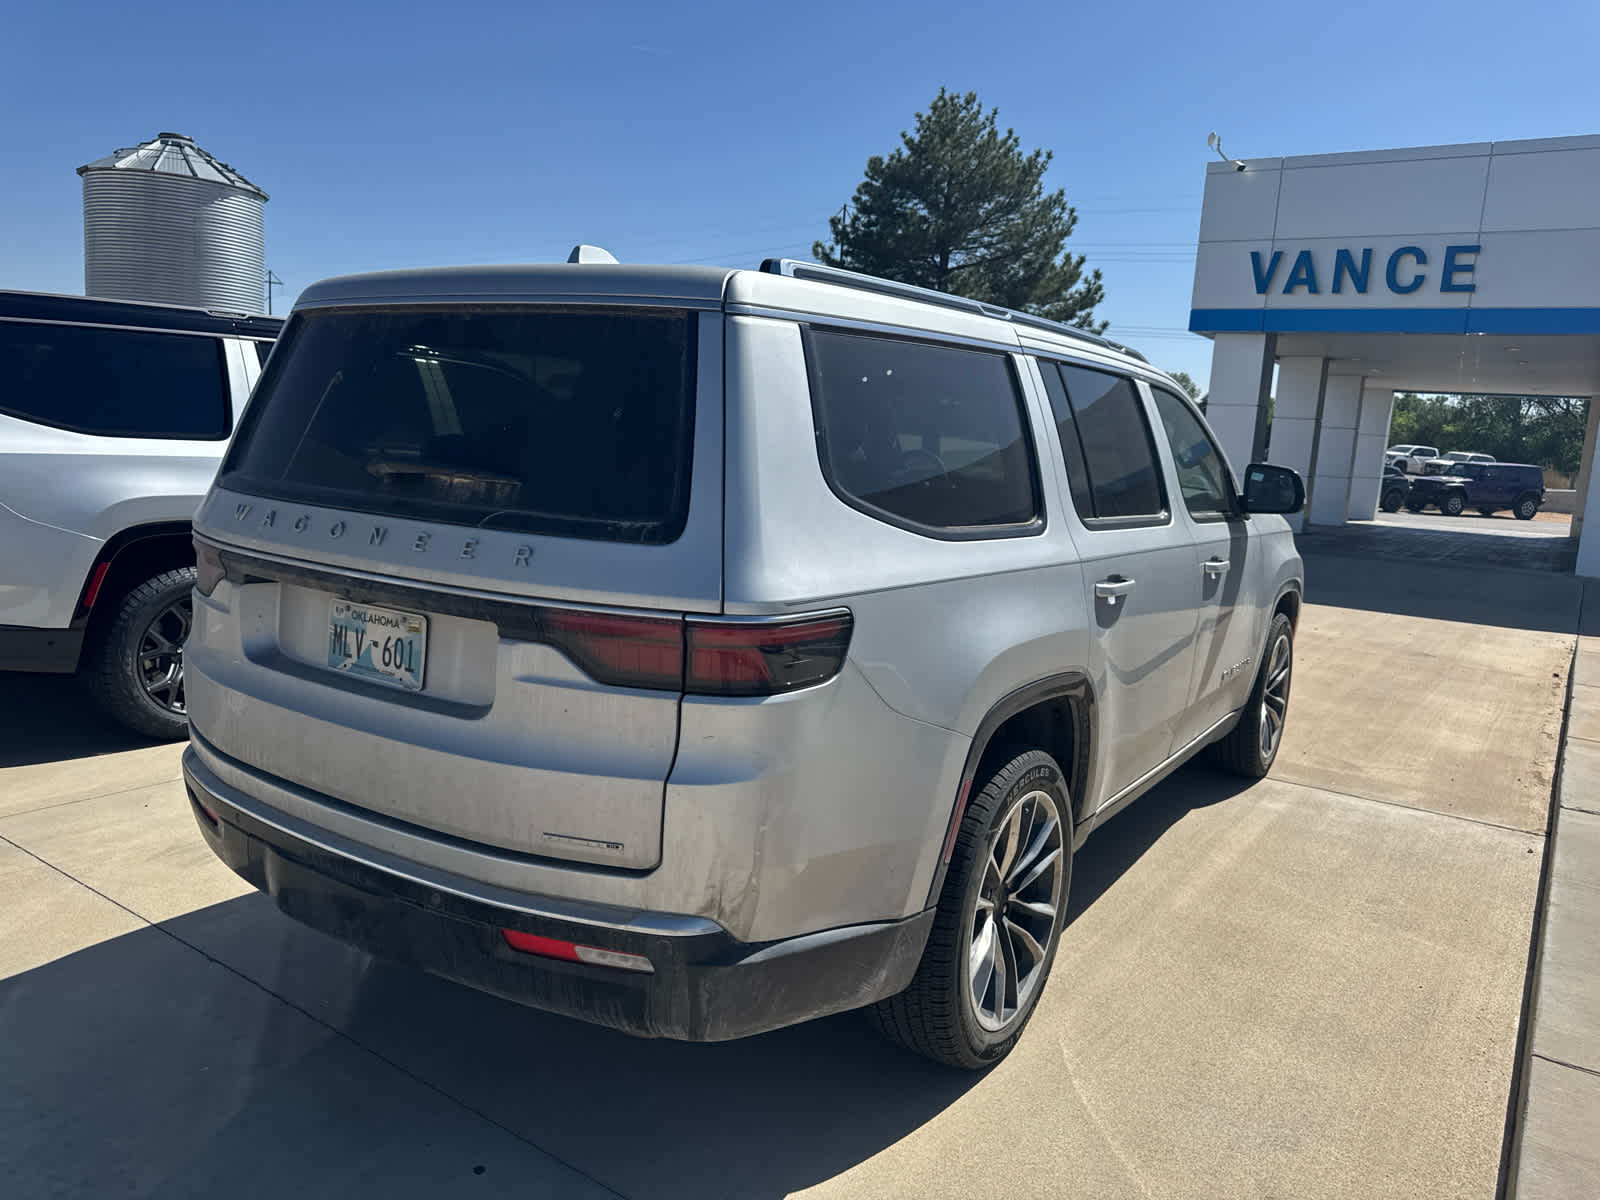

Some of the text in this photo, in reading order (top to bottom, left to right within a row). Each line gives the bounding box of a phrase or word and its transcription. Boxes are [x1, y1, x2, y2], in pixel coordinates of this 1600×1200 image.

[1250, 244, 1481, 295] VANCE
[233, 503, 534, 567] WAGONEER
[351, 609, 401, 629] OKLAHOMA
